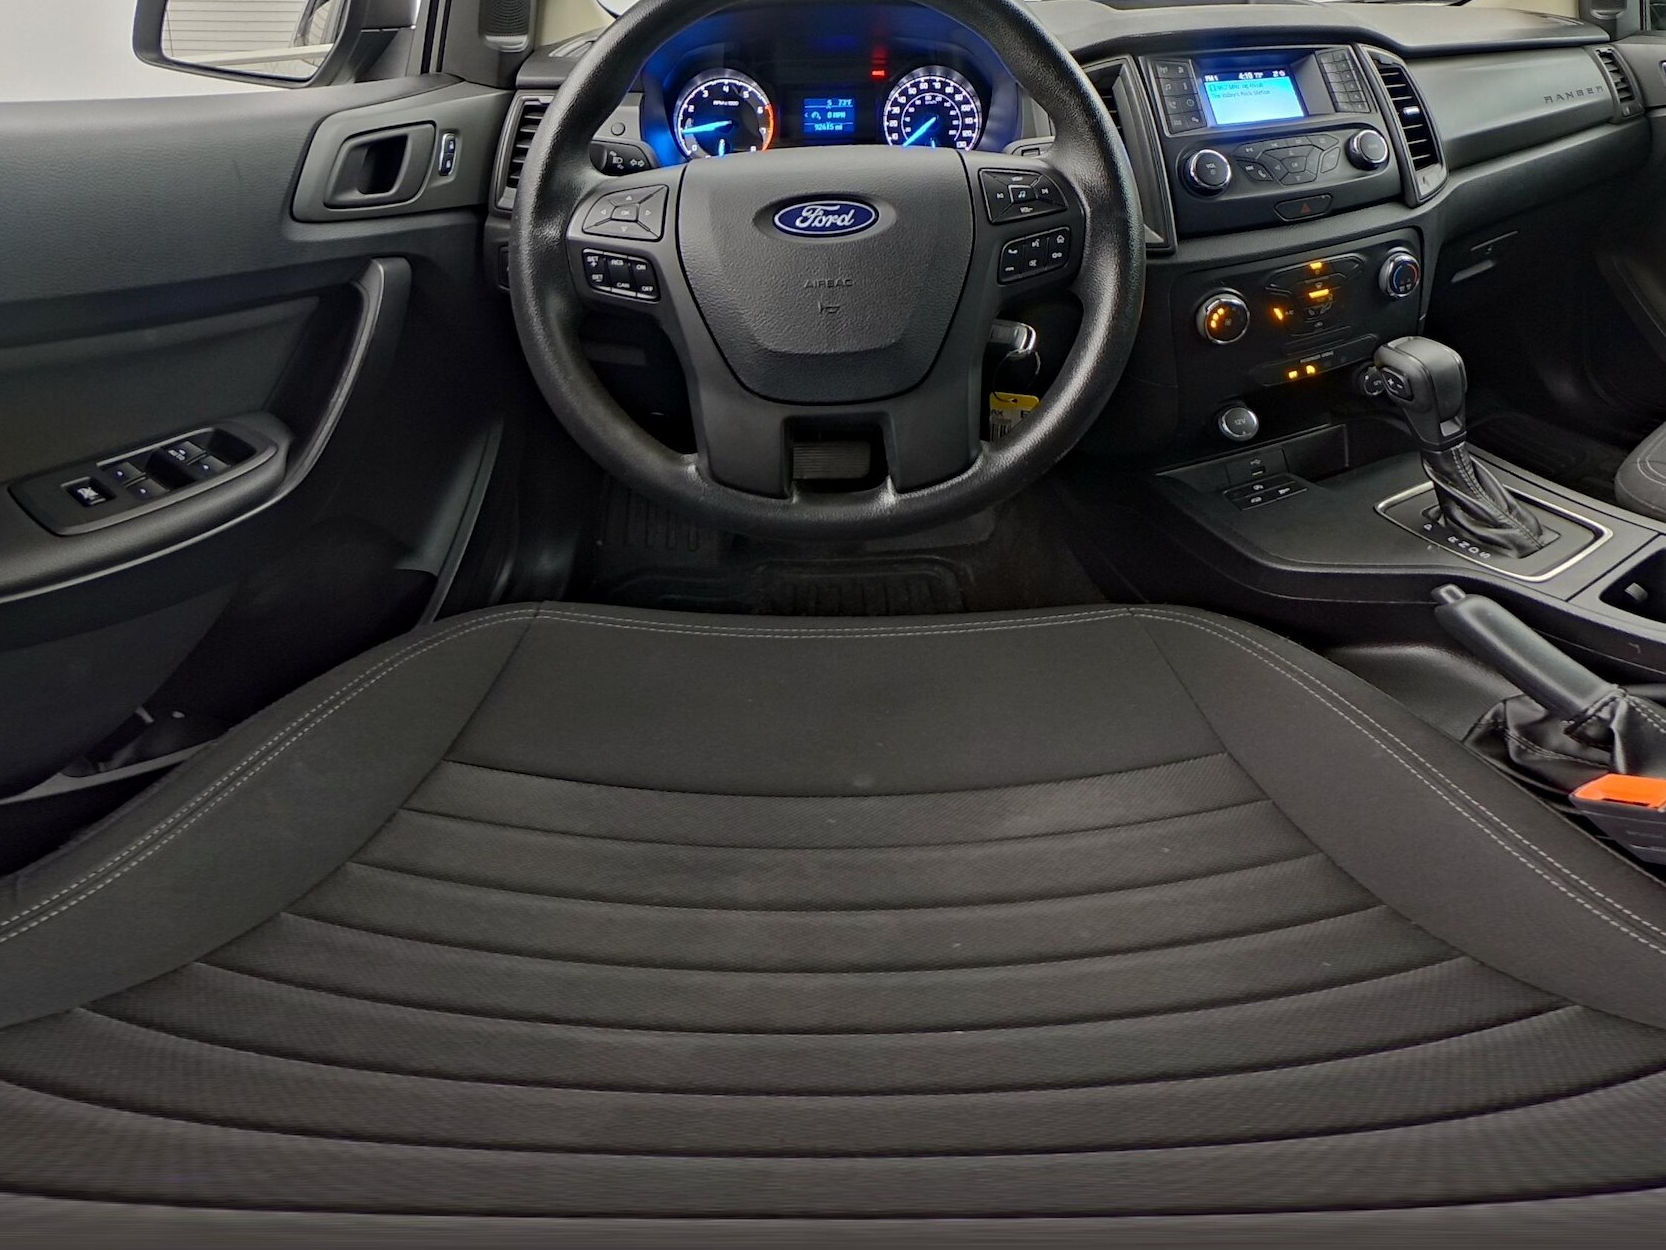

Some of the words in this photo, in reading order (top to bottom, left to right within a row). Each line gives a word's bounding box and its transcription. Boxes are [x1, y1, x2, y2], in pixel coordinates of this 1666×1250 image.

[1543, 86, 1603, 103] RANGER
[795, 205, 856, 228] Ford
[804, 279, 856, 289] AIRBAG
